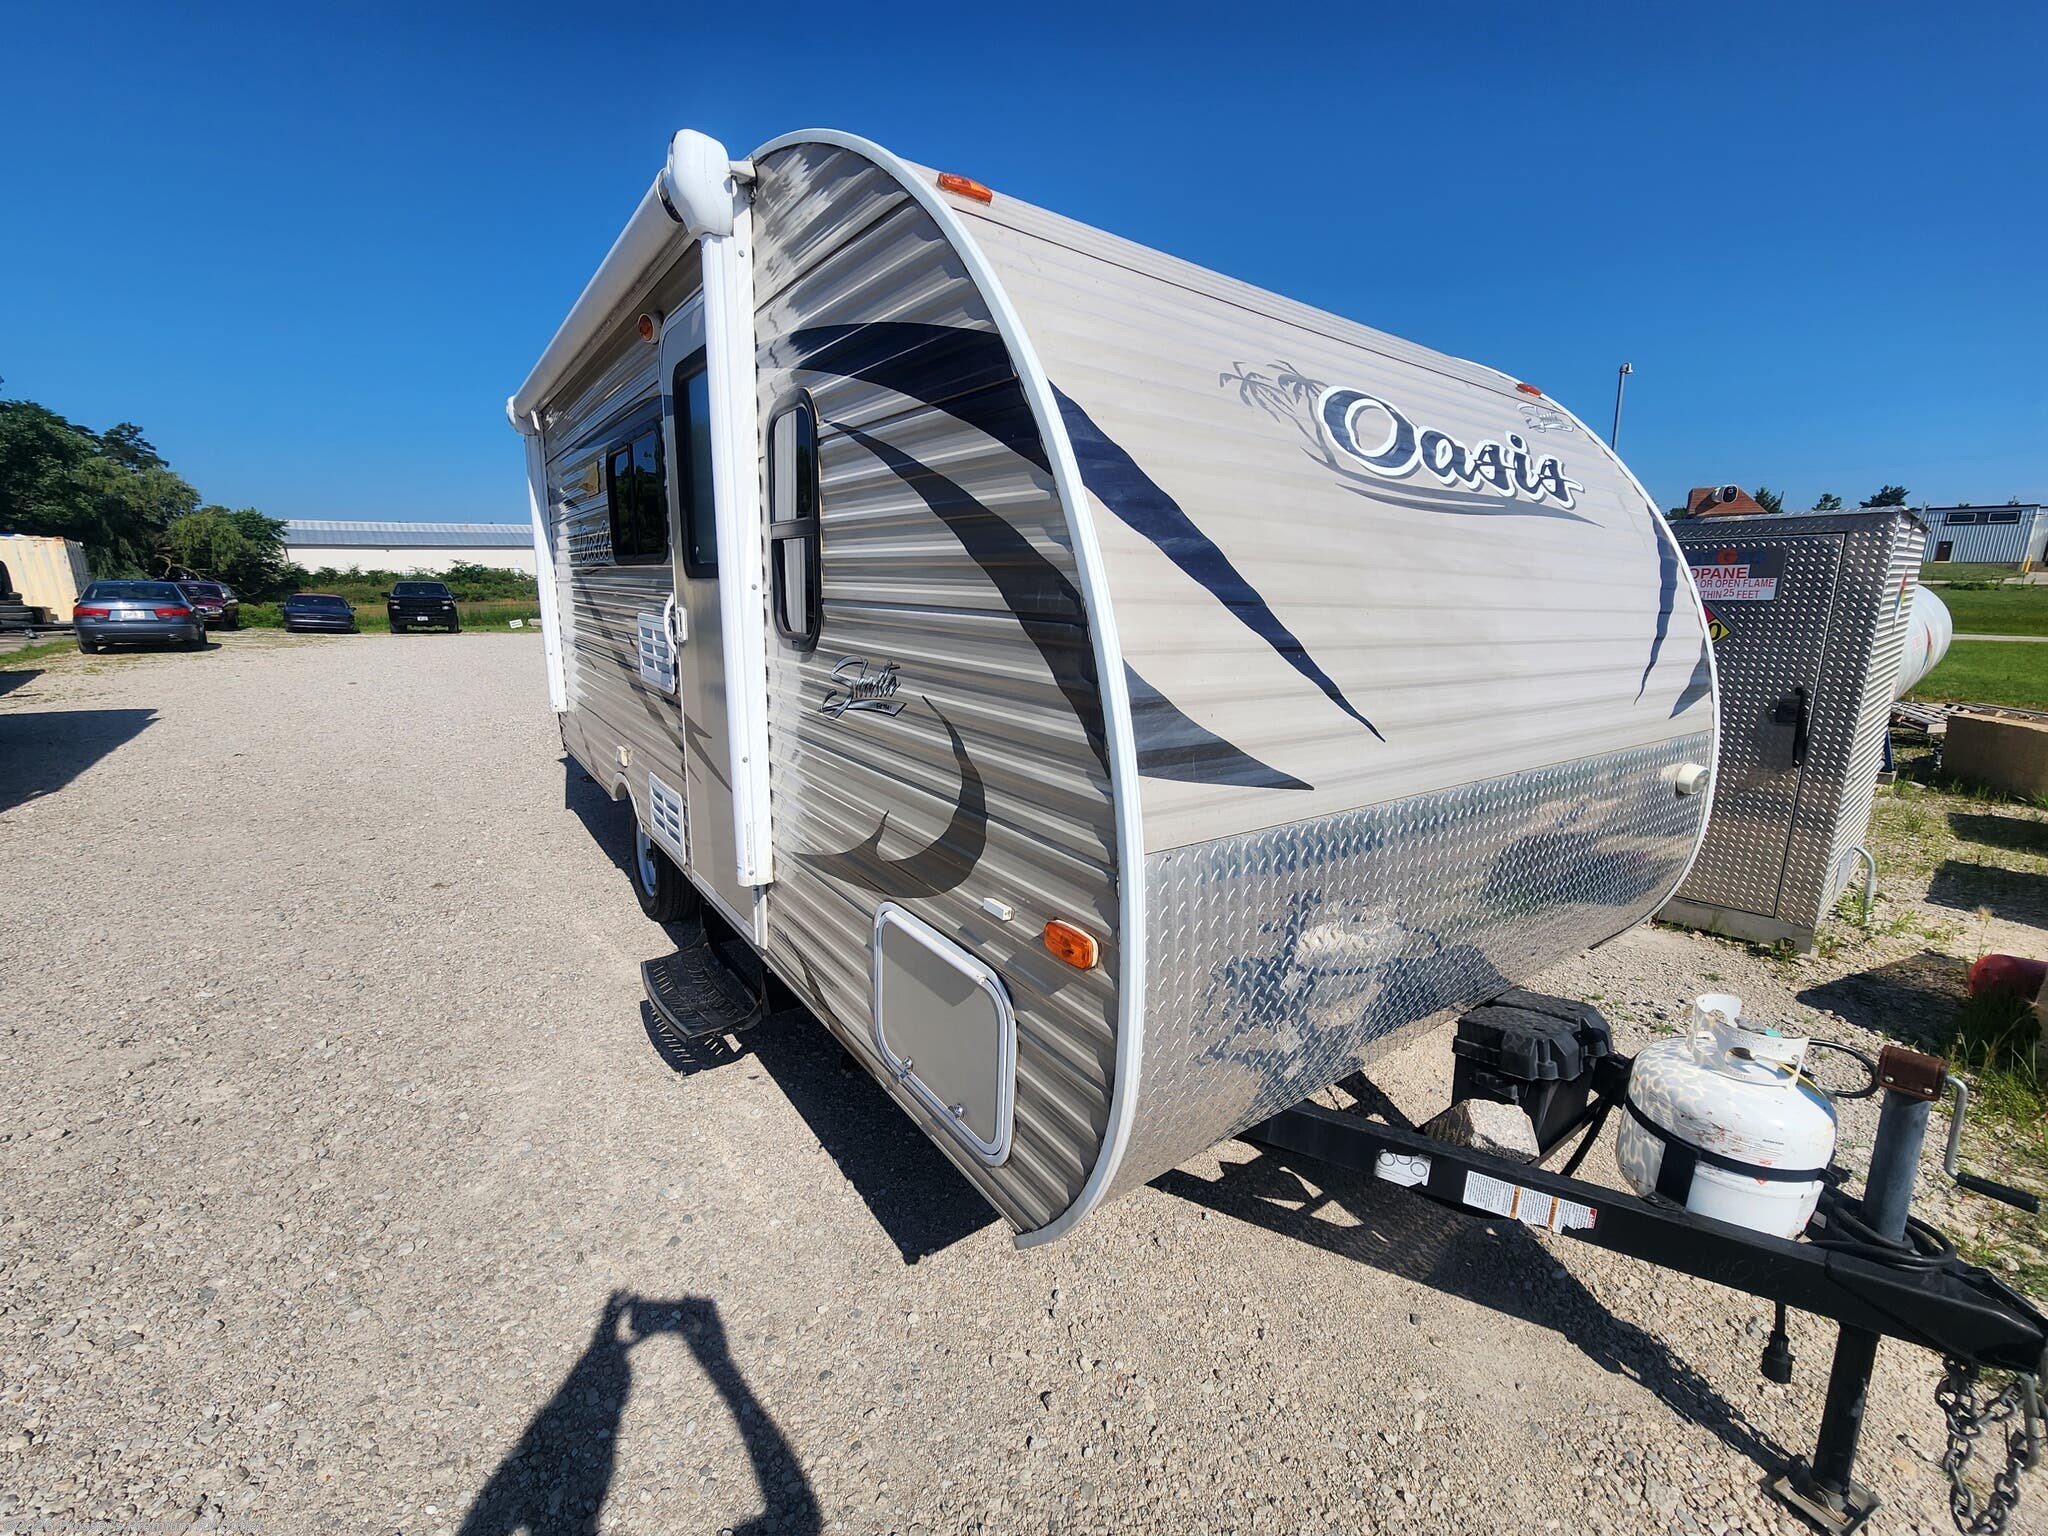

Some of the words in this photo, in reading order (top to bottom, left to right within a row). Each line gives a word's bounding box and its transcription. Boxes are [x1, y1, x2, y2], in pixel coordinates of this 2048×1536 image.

[1317, 386, 1584, 509] Oasis
[1700, 579, 1713, 588] OR
[1715, 579, 1740, 588] OPEN
[1743, 578, 1775, 588] FLAME
[1723, 588, 1735, 597] 25
[1736, 590, 1760, 599] FEET
